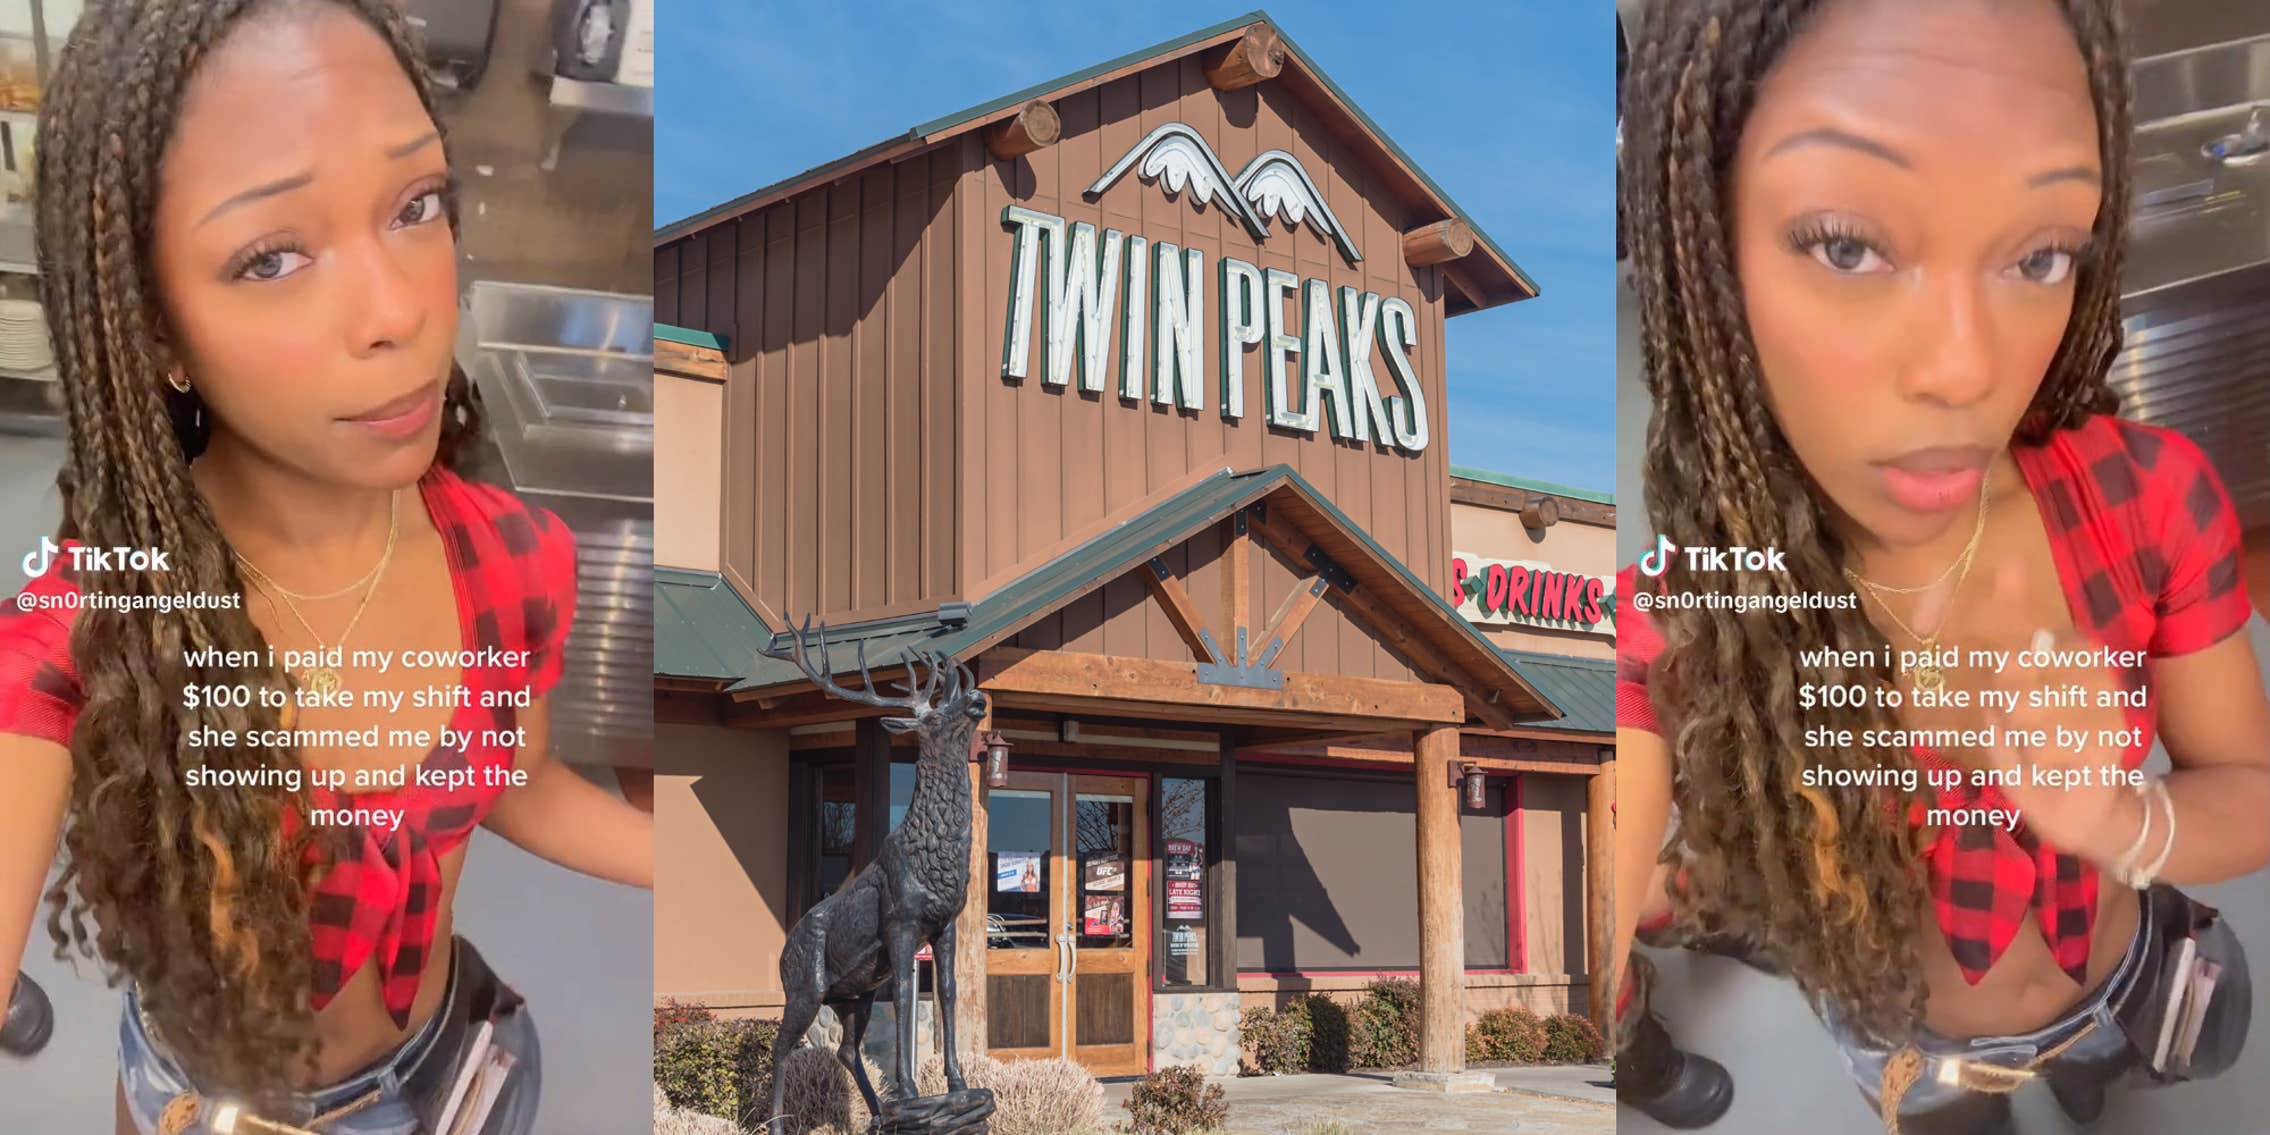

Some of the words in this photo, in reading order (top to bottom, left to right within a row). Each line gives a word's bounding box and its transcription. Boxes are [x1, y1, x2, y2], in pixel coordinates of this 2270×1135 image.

[1001, 204, 1204, 410] TWIN
[1219, 256, 1429, 451] PEAKS
[1484, 563, 1604, 624] DRINKS
[1096, 867, 1113, 875] UFC
